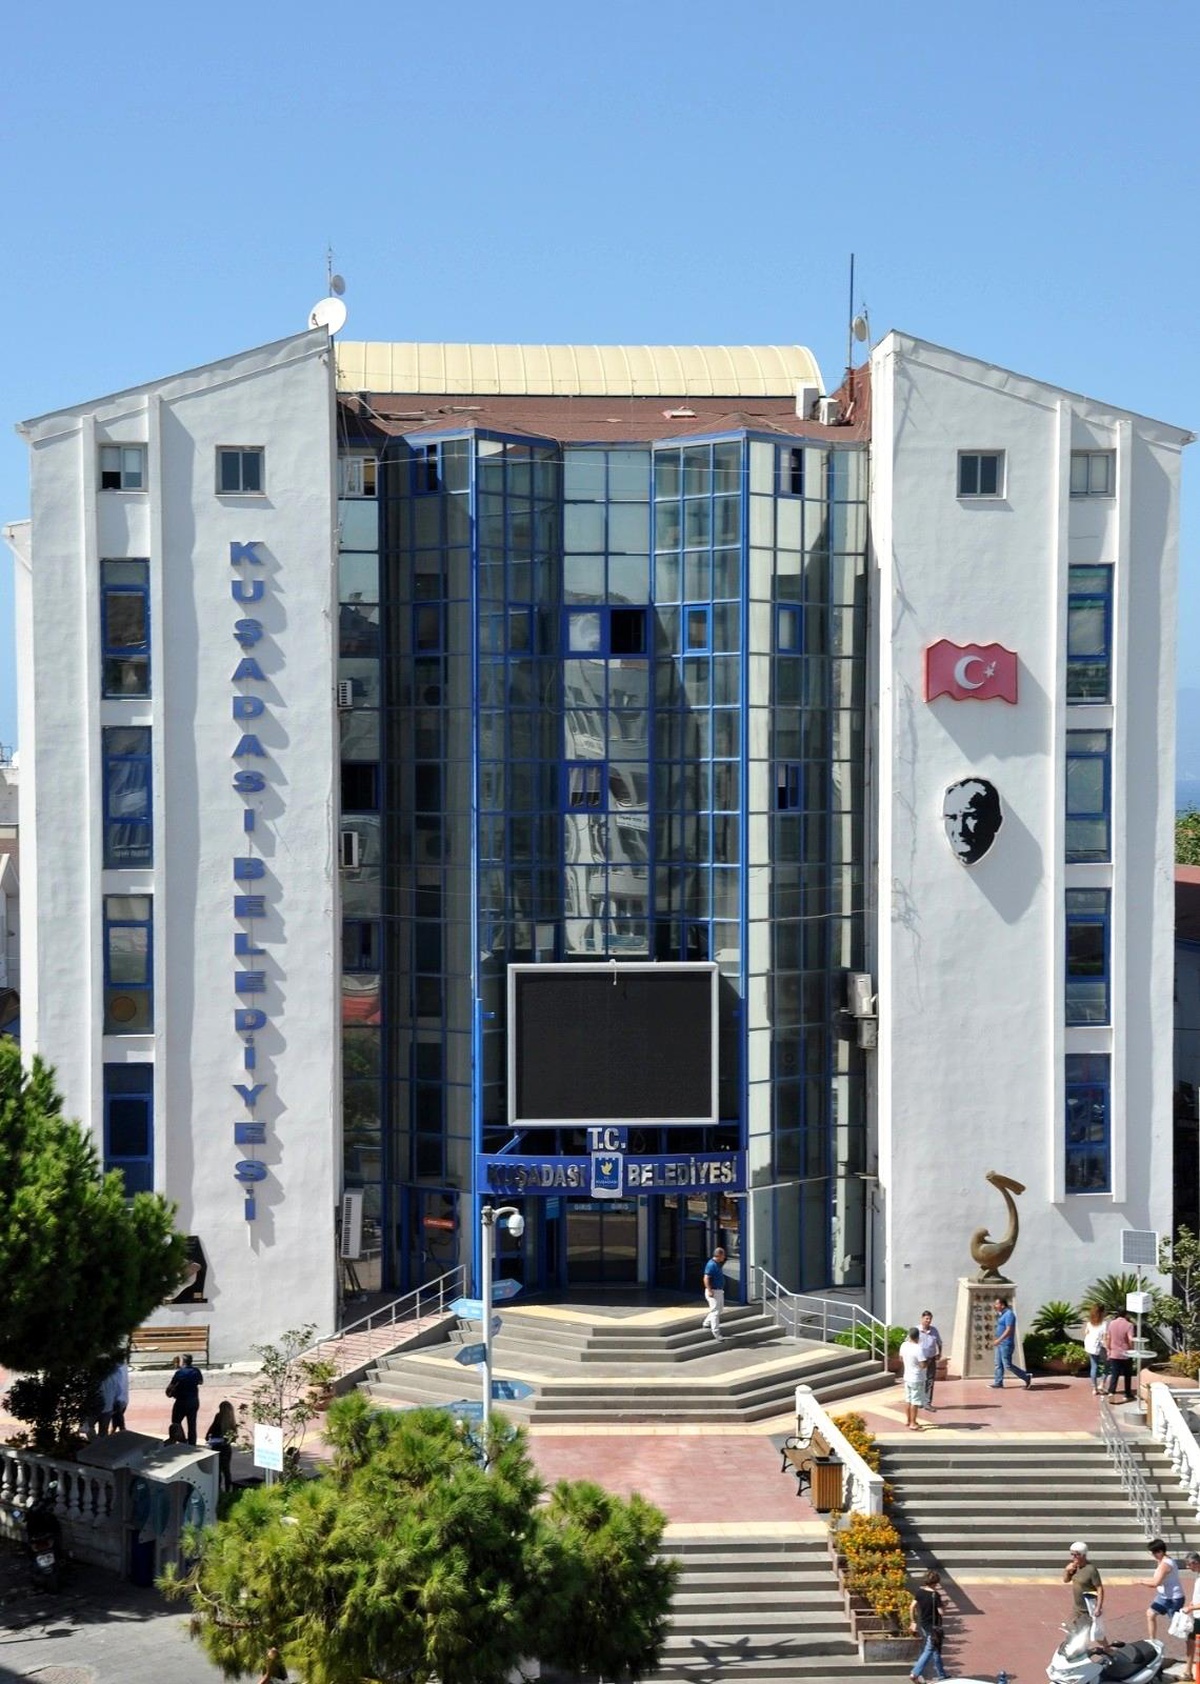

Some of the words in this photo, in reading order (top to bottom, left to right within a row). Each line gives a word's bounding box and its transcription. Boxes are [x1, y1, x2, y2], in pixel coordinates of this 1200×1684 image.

[230, 541, 268, 832] KUŞADASI
[233, 857, 268, 1220] BELEDİYESİ
[487, 1162, 587, 1192] KUŞADASI
[627, 1157, 737, 1187] BELEDİYESİ
[587, 1127, 626, 1150] T.C.
